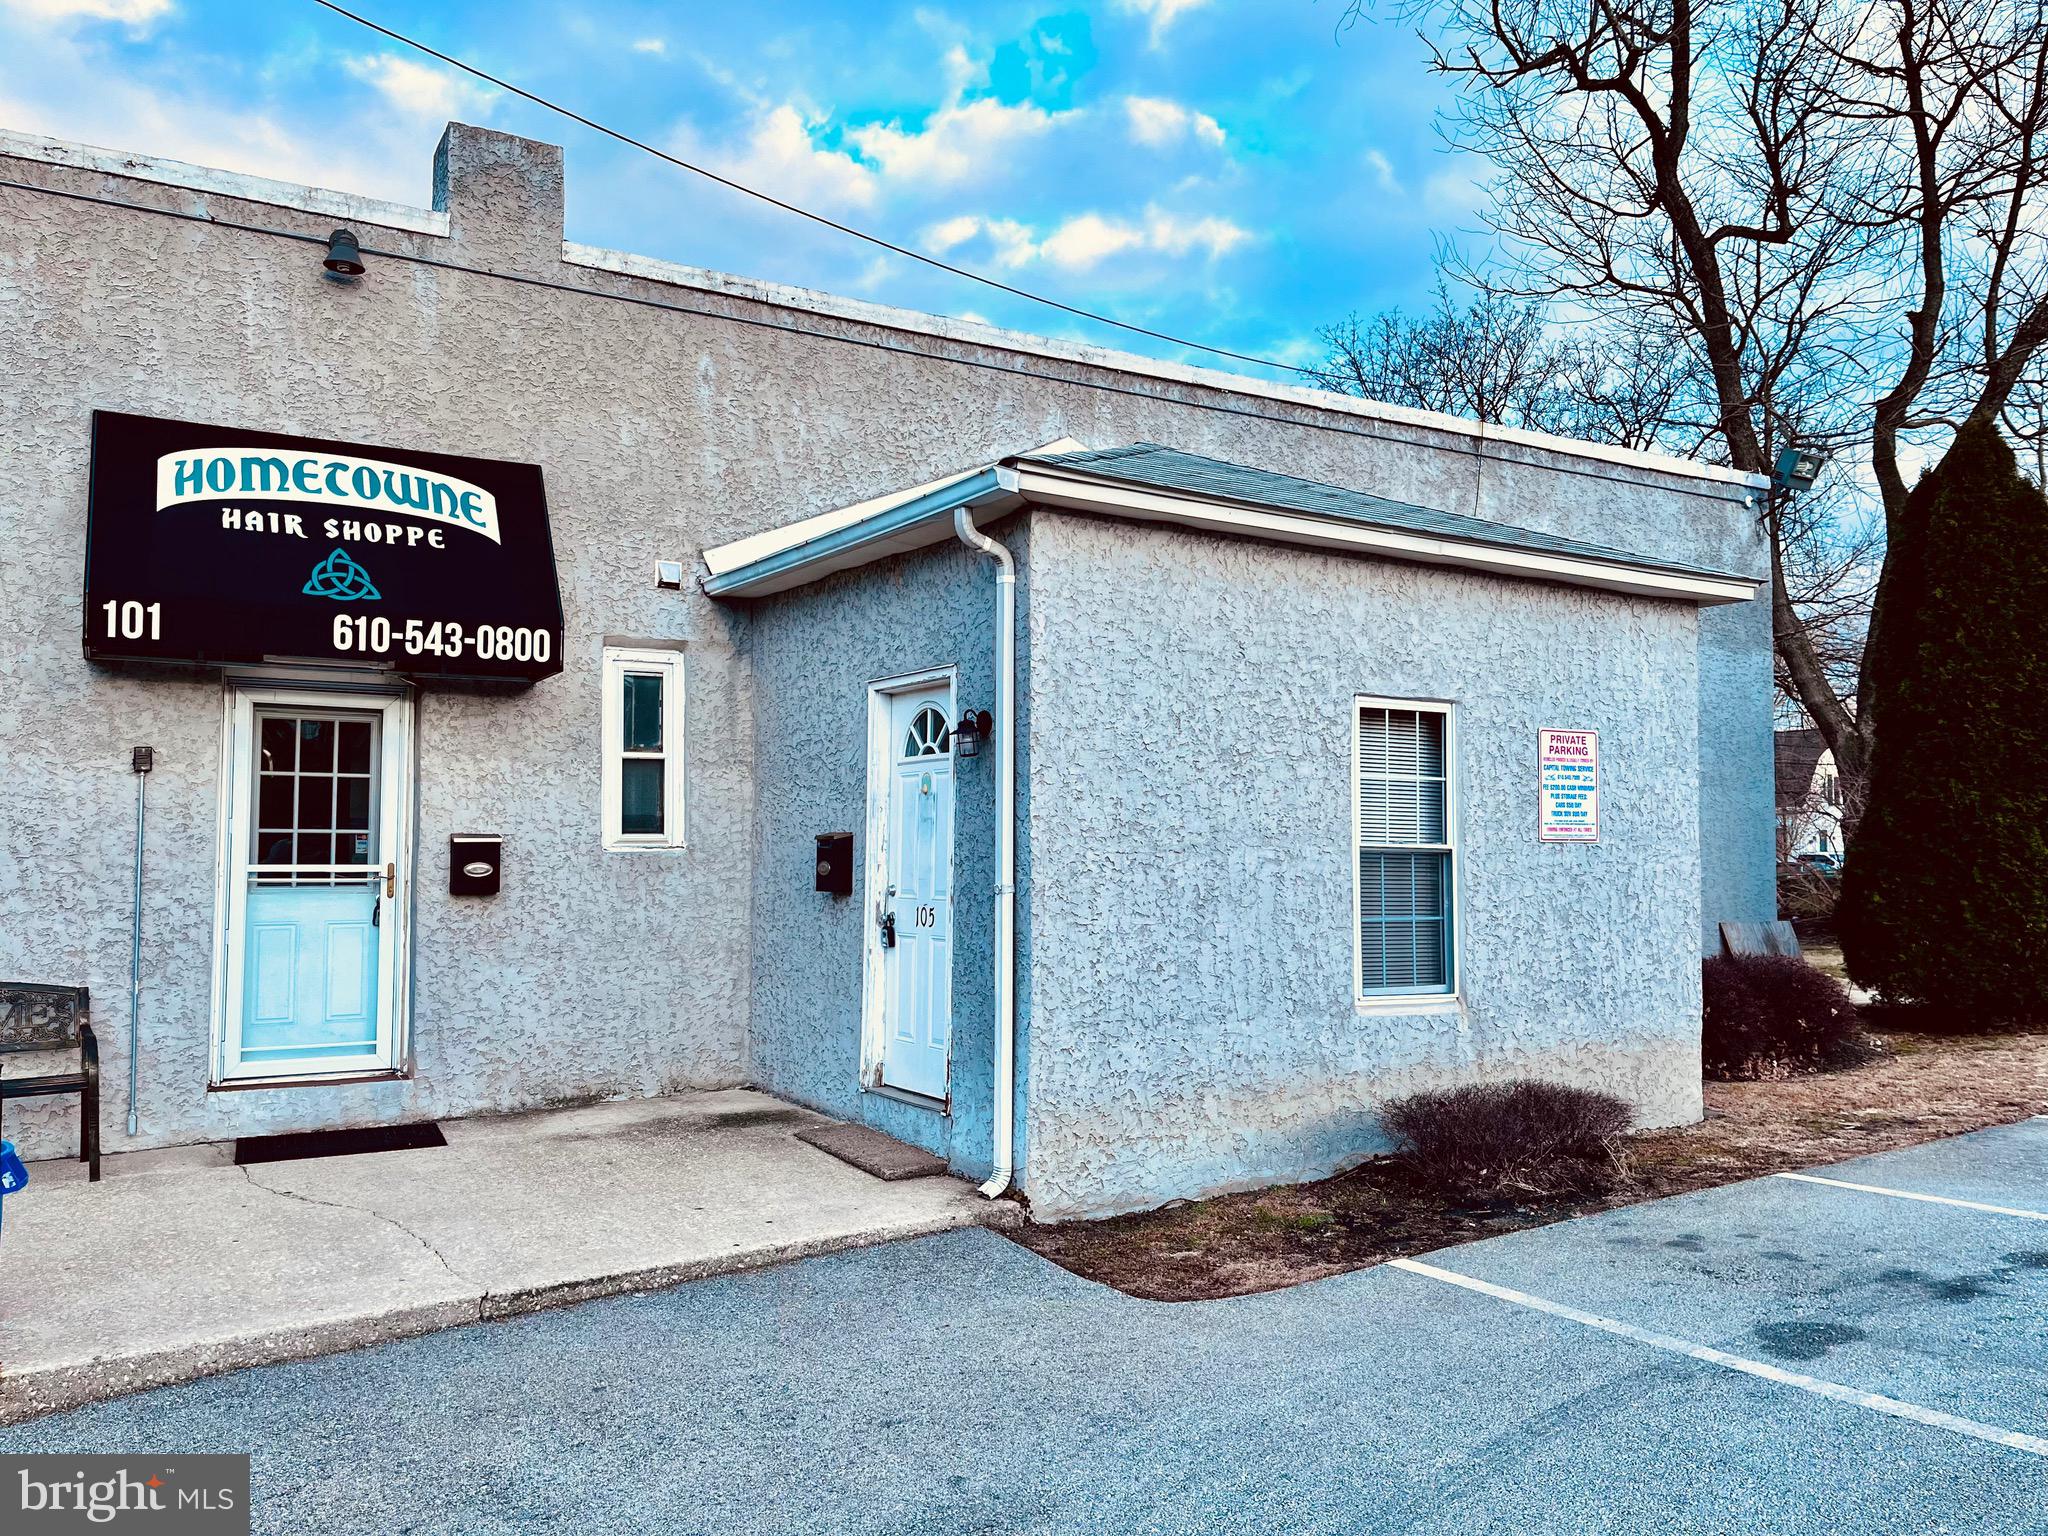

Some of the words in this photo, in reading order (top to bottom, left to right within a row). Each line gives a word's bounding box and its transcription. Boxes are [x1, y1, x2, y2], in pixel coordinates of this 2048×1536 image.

[175, 456, 487, 528] HOMETOWNE
[222, 507, 308, 539] HAIR
[324, 518, 446, 549] SHOPPE
[103, 600, 161, 640] 101
[333, 614, 551, 663] 610-543-0800
[1549, 745, 1589, 756] PARKING
[1550, 734, 1587, 745] PRIVATE
[915, 906, 935, 928] 105
